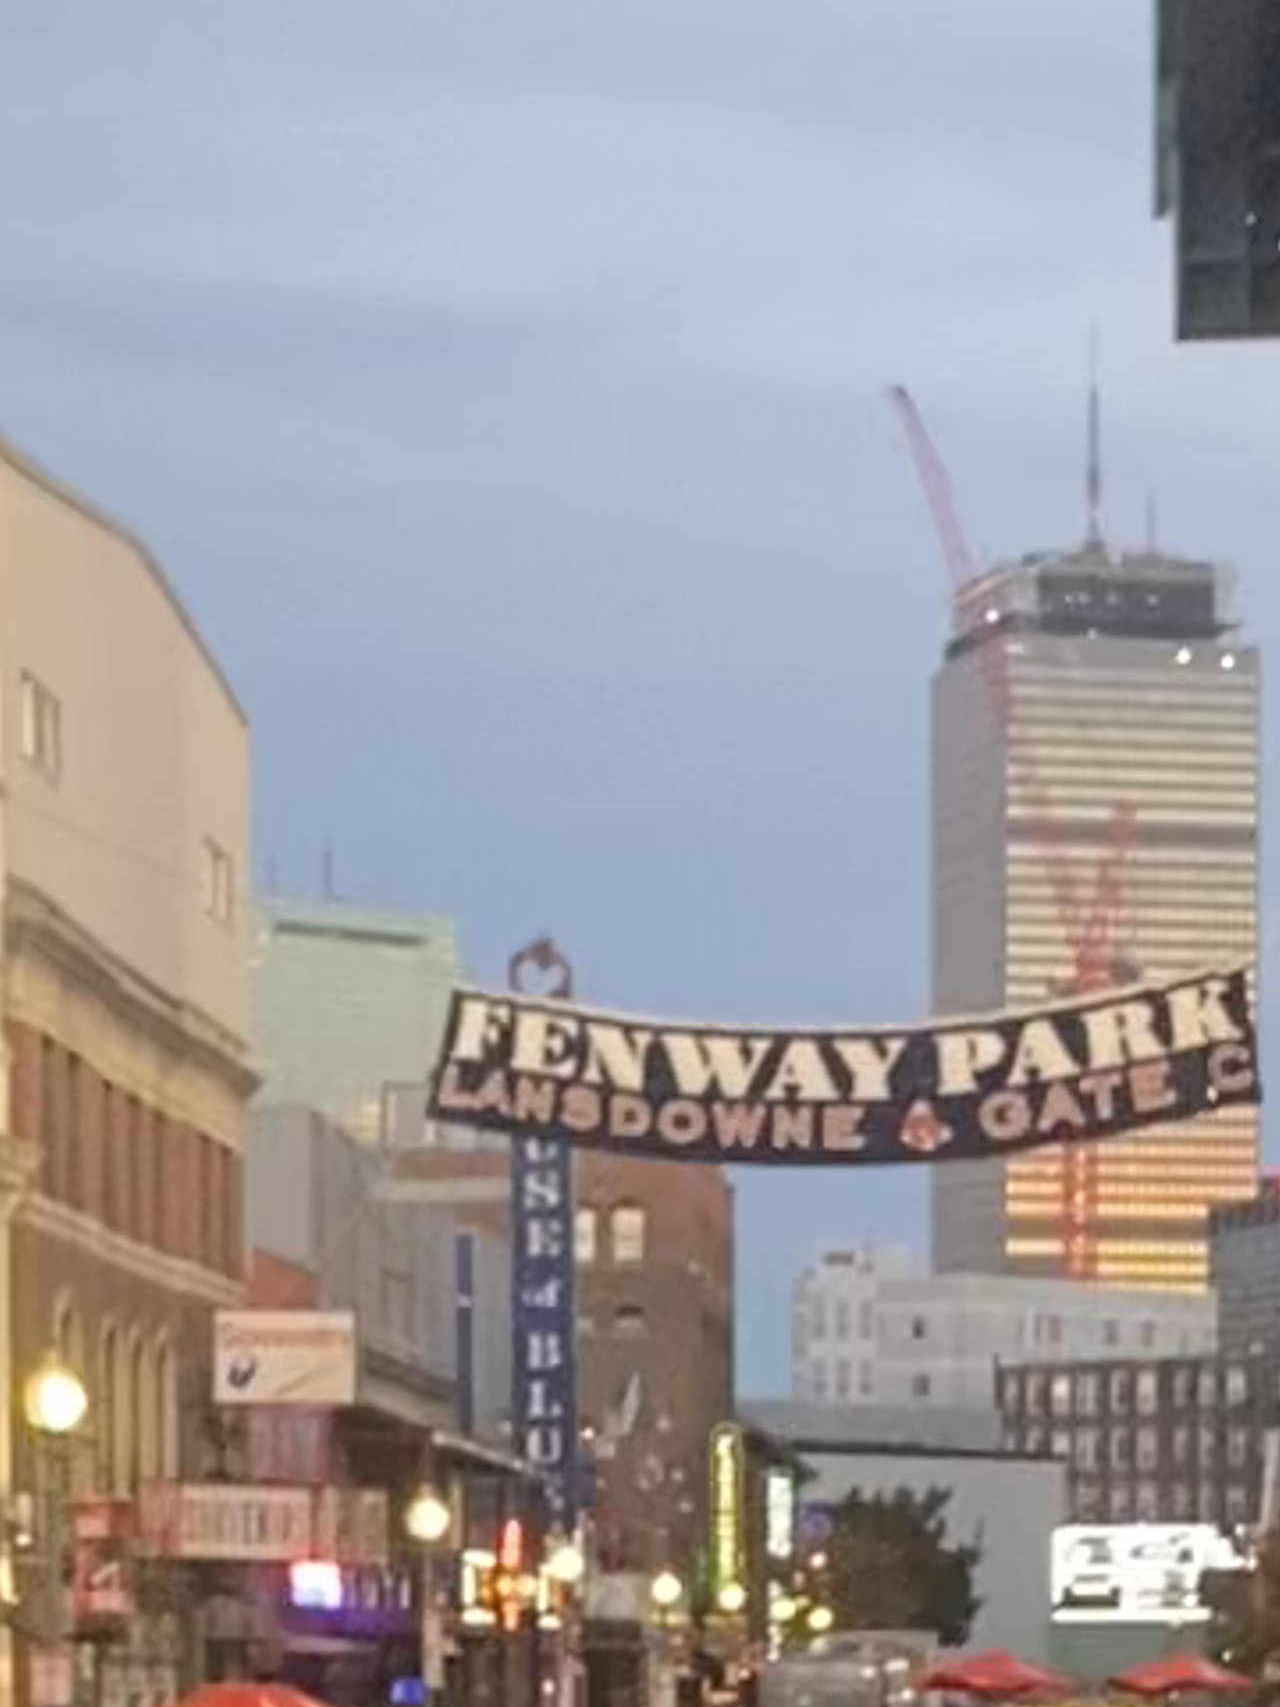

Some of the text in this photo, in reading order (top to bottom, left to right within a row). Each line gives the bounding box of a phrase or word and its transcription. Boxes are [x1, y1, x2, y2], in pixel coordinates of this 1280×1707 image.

[439, 1042, 1253, 1153] LANSDOWNE GATE C
[452, 981, 1243, 1103] FENWAY PARK
